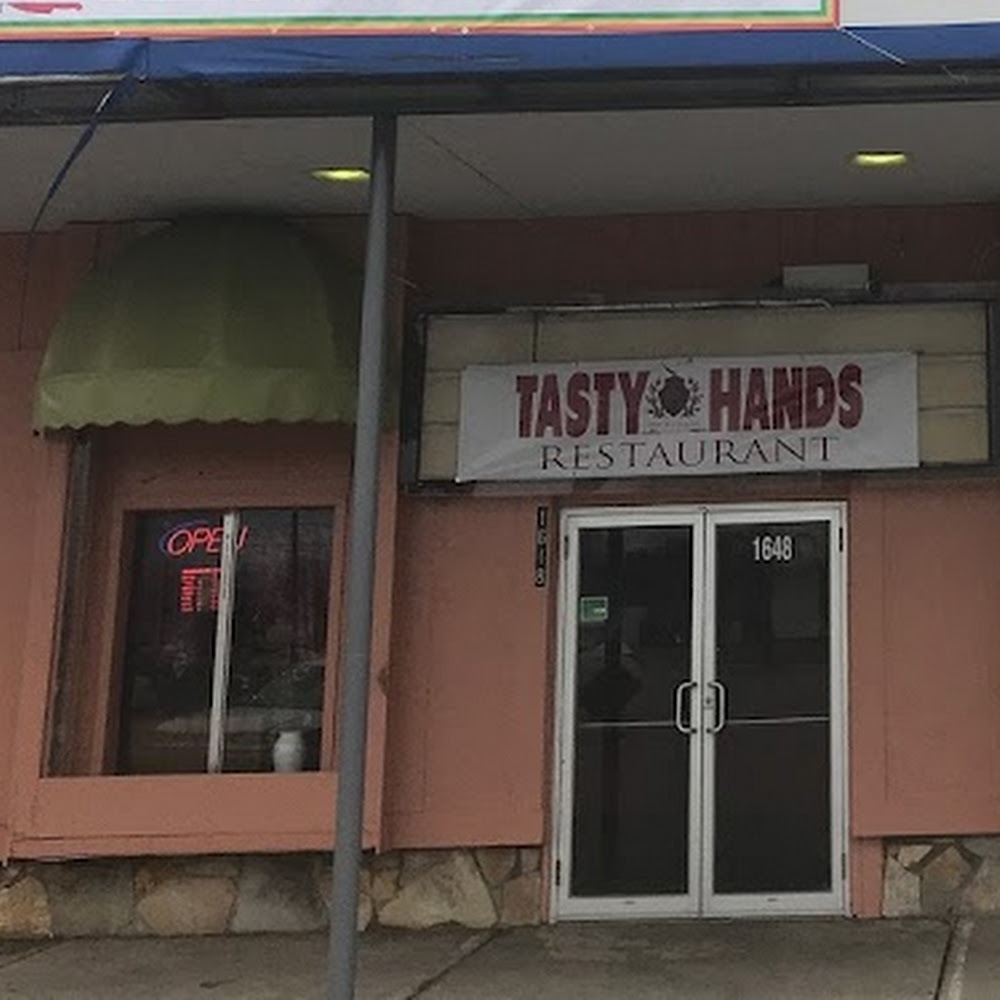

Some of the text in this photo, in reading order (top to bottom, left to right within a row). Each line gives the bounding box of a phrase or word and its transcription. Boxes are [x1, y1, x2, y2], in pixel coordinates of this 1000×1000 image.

[516, 363, 863, 439] TASTY HANDS
[540, 436, 839, 470] RESTAURANT
[752, 535, 793, 561] 1648
